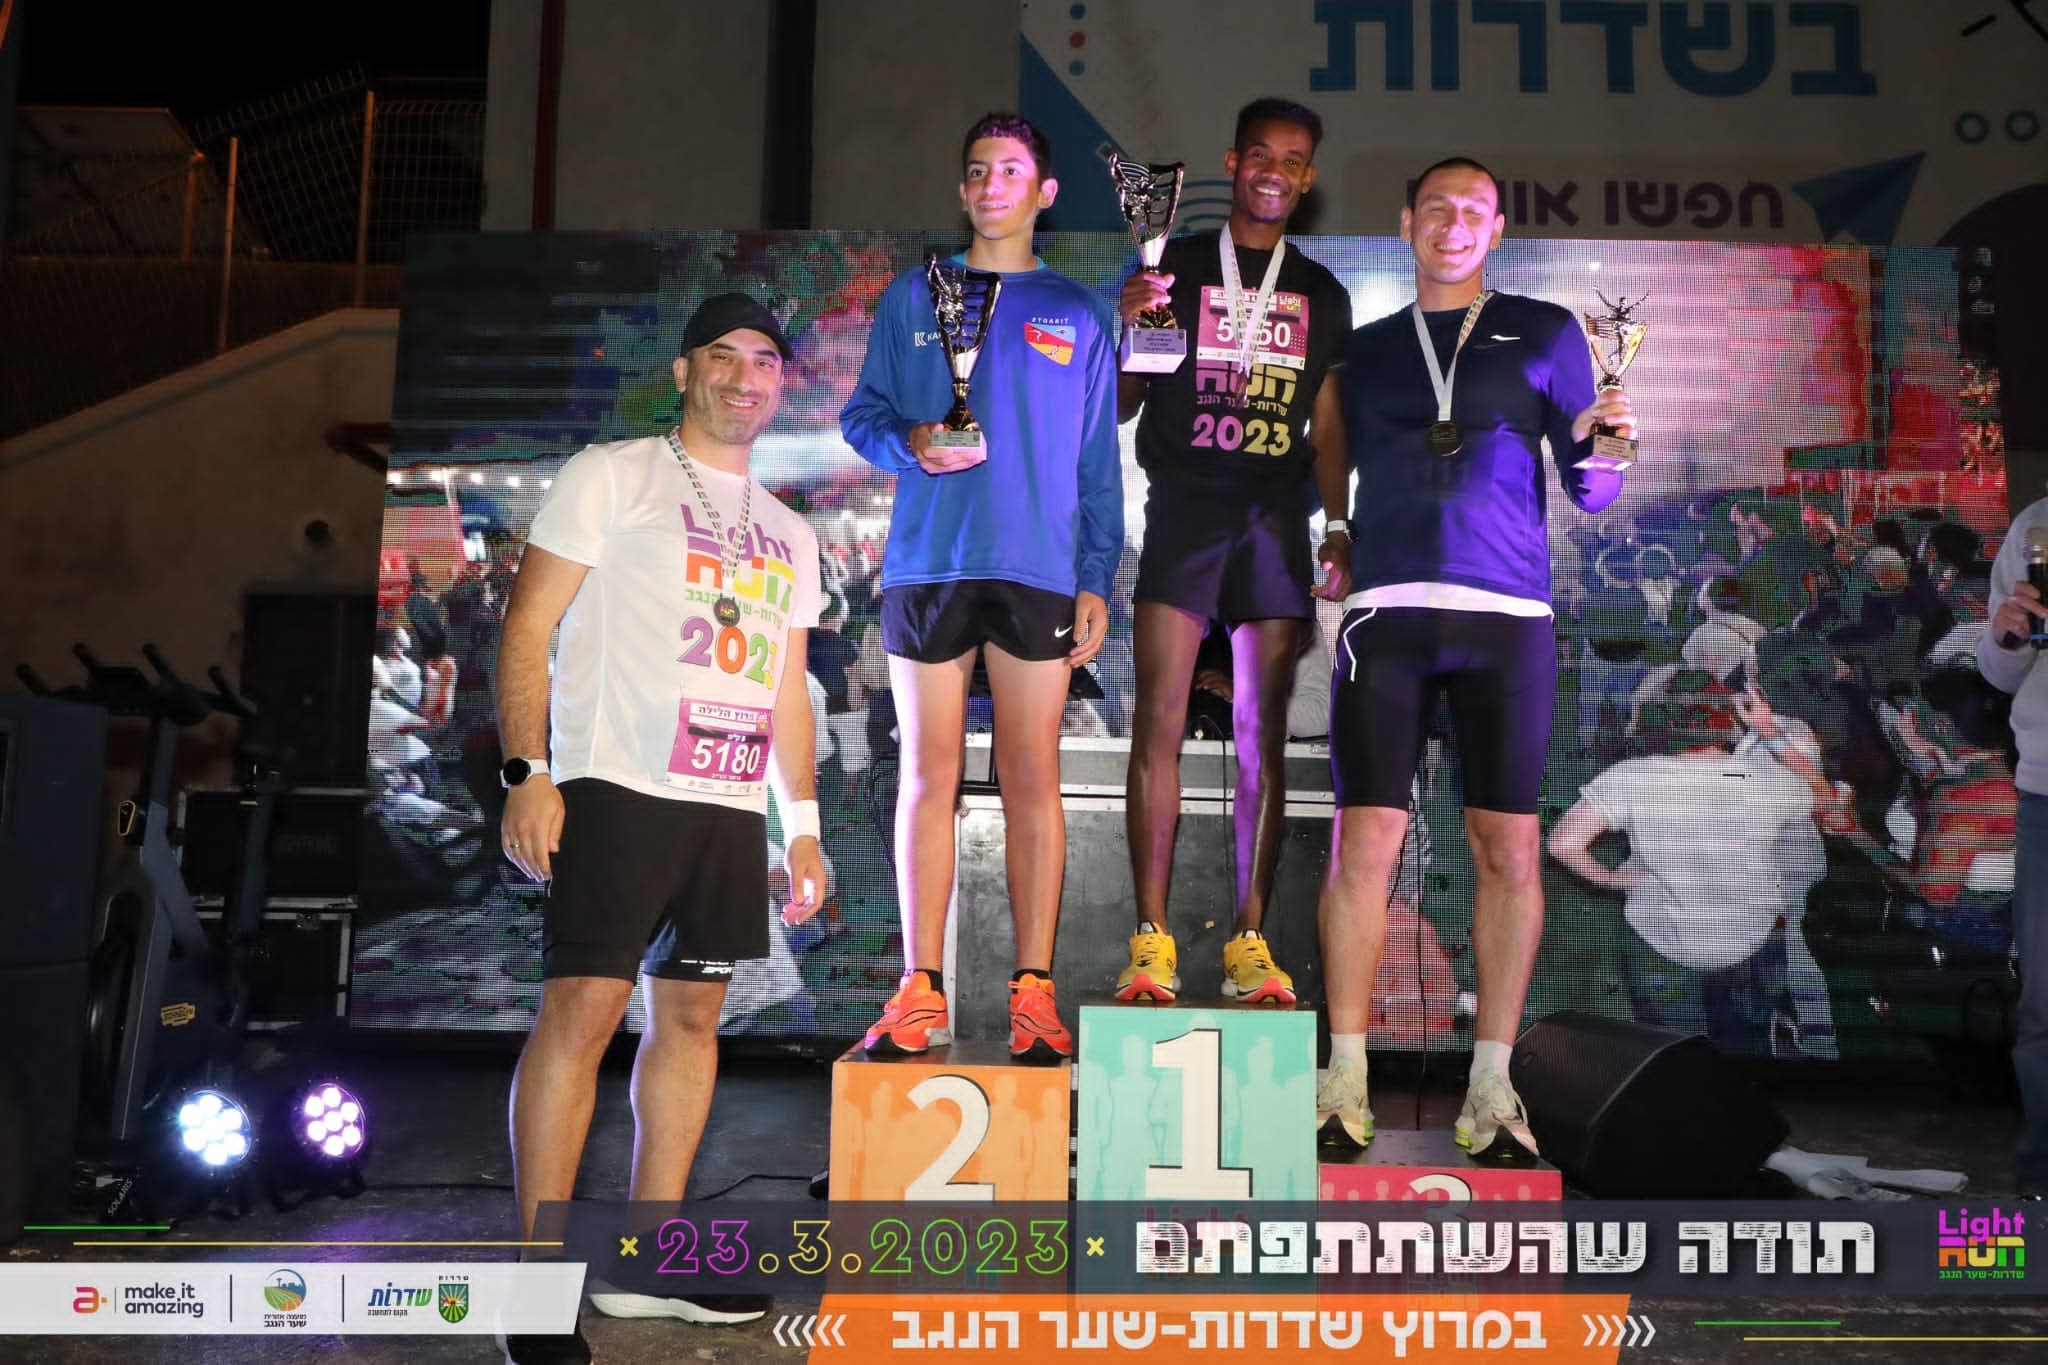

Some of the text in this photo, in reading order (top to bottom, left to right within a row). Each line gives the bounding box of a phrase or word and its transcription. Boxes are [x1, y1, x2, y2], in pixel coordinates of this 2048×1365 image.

[1309, 0, 1878, 97] בשדרות
[1604, 180, 1784, 229] חפשו
[1216, 317, 1291, 348] 550
[1191, 412, 1292, 457] 2023
[680, 503, 794, 566] Lght
[691, 737, 761, 775] 5180
[905, 1074, 996, 1204] 2
[1145, 1027, 1254, 1201] 1
